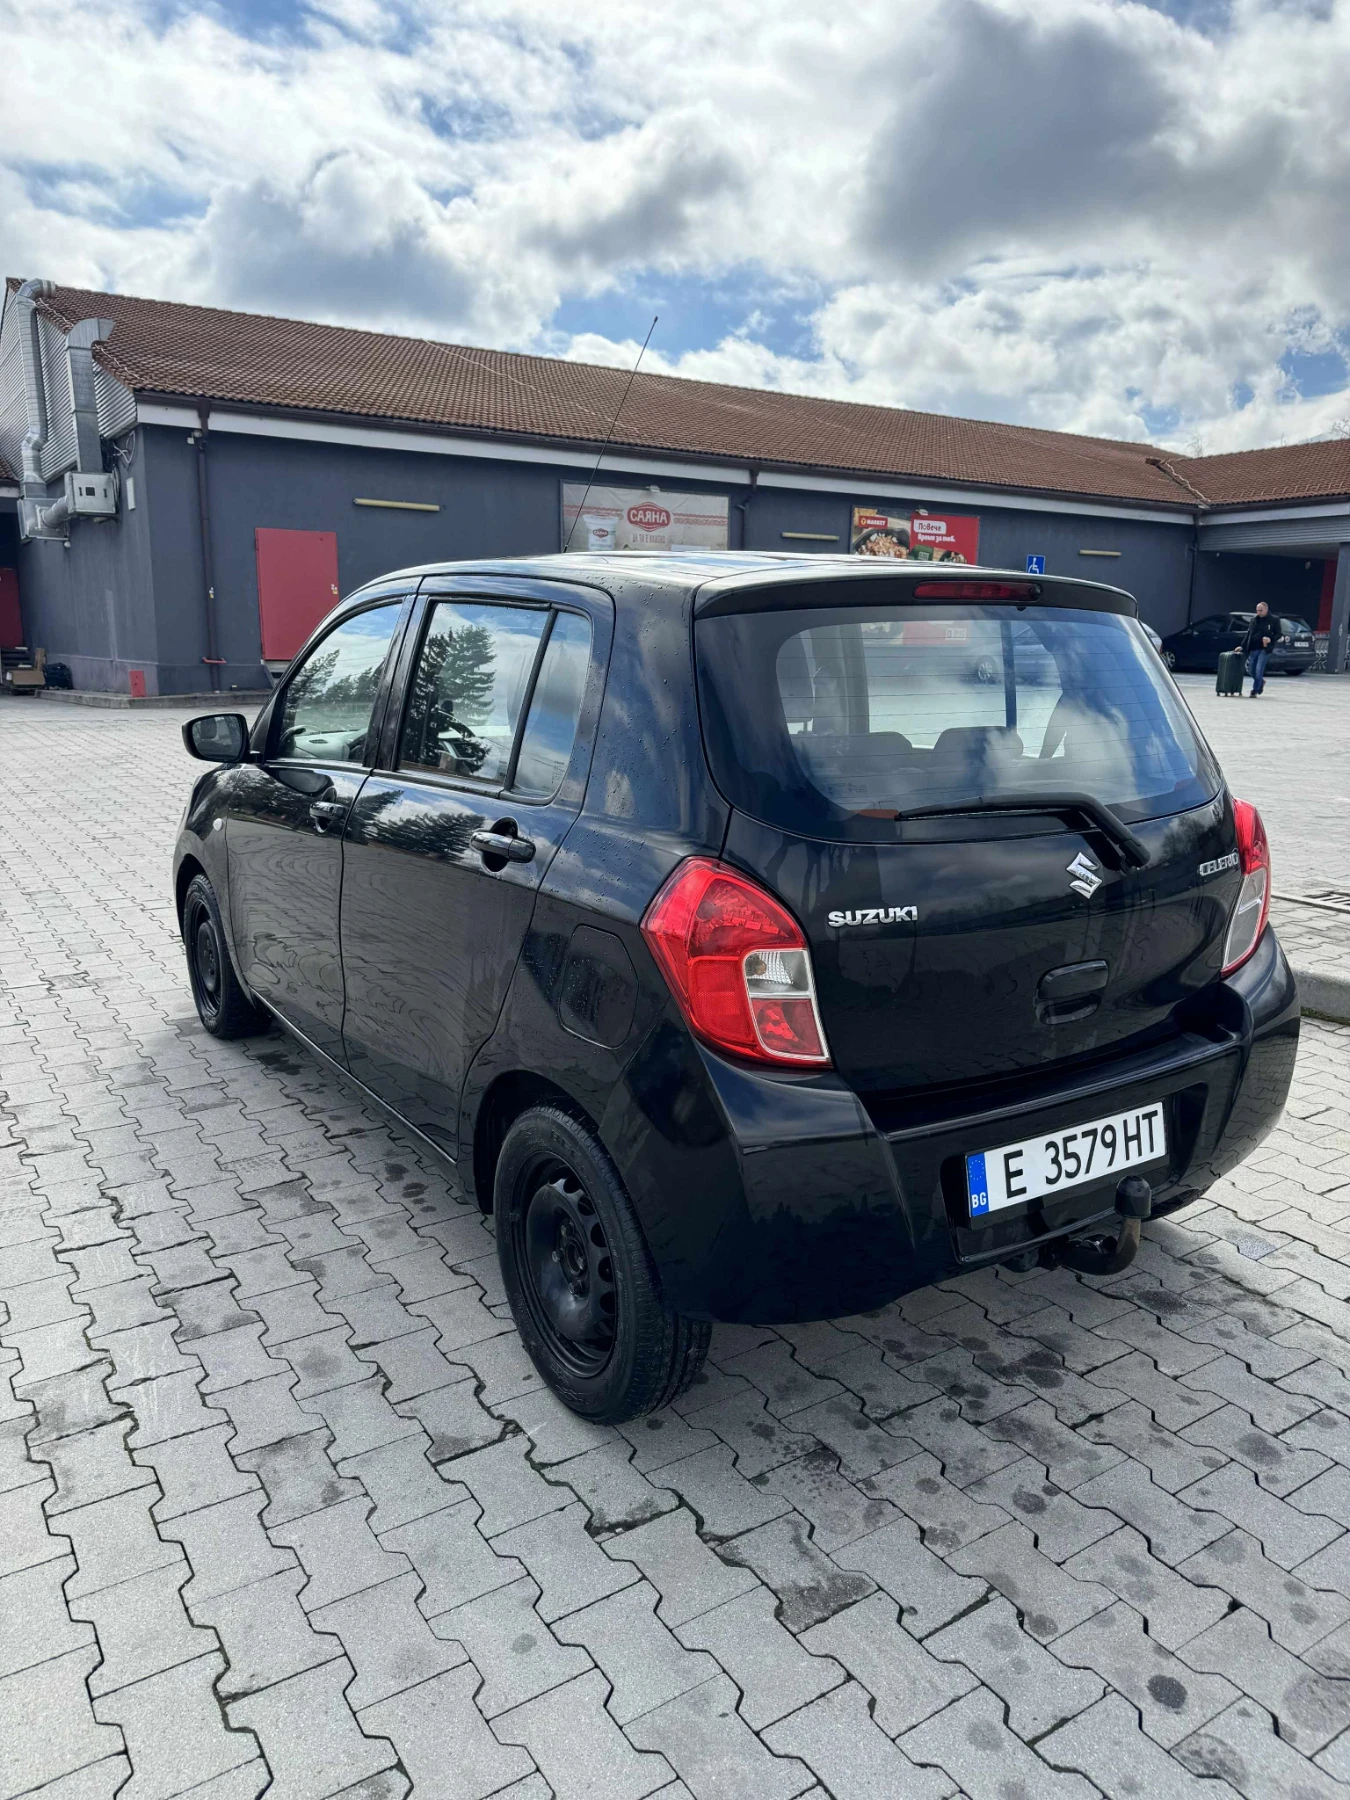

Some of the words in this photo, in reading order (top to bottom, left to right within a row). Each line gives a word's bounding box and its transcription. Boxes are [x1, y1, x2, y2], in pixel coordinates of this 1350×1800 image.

[630, 510, 668, 524] САЯНА
[918, 522, 942, 532] Повече
[1199, 852, 1239, 877] CELERIO
[828, 905, 918, 927] SUZUKI
[1003, 1149, 1027, 1199] E
[971, 1191, 987, 1208] BG
